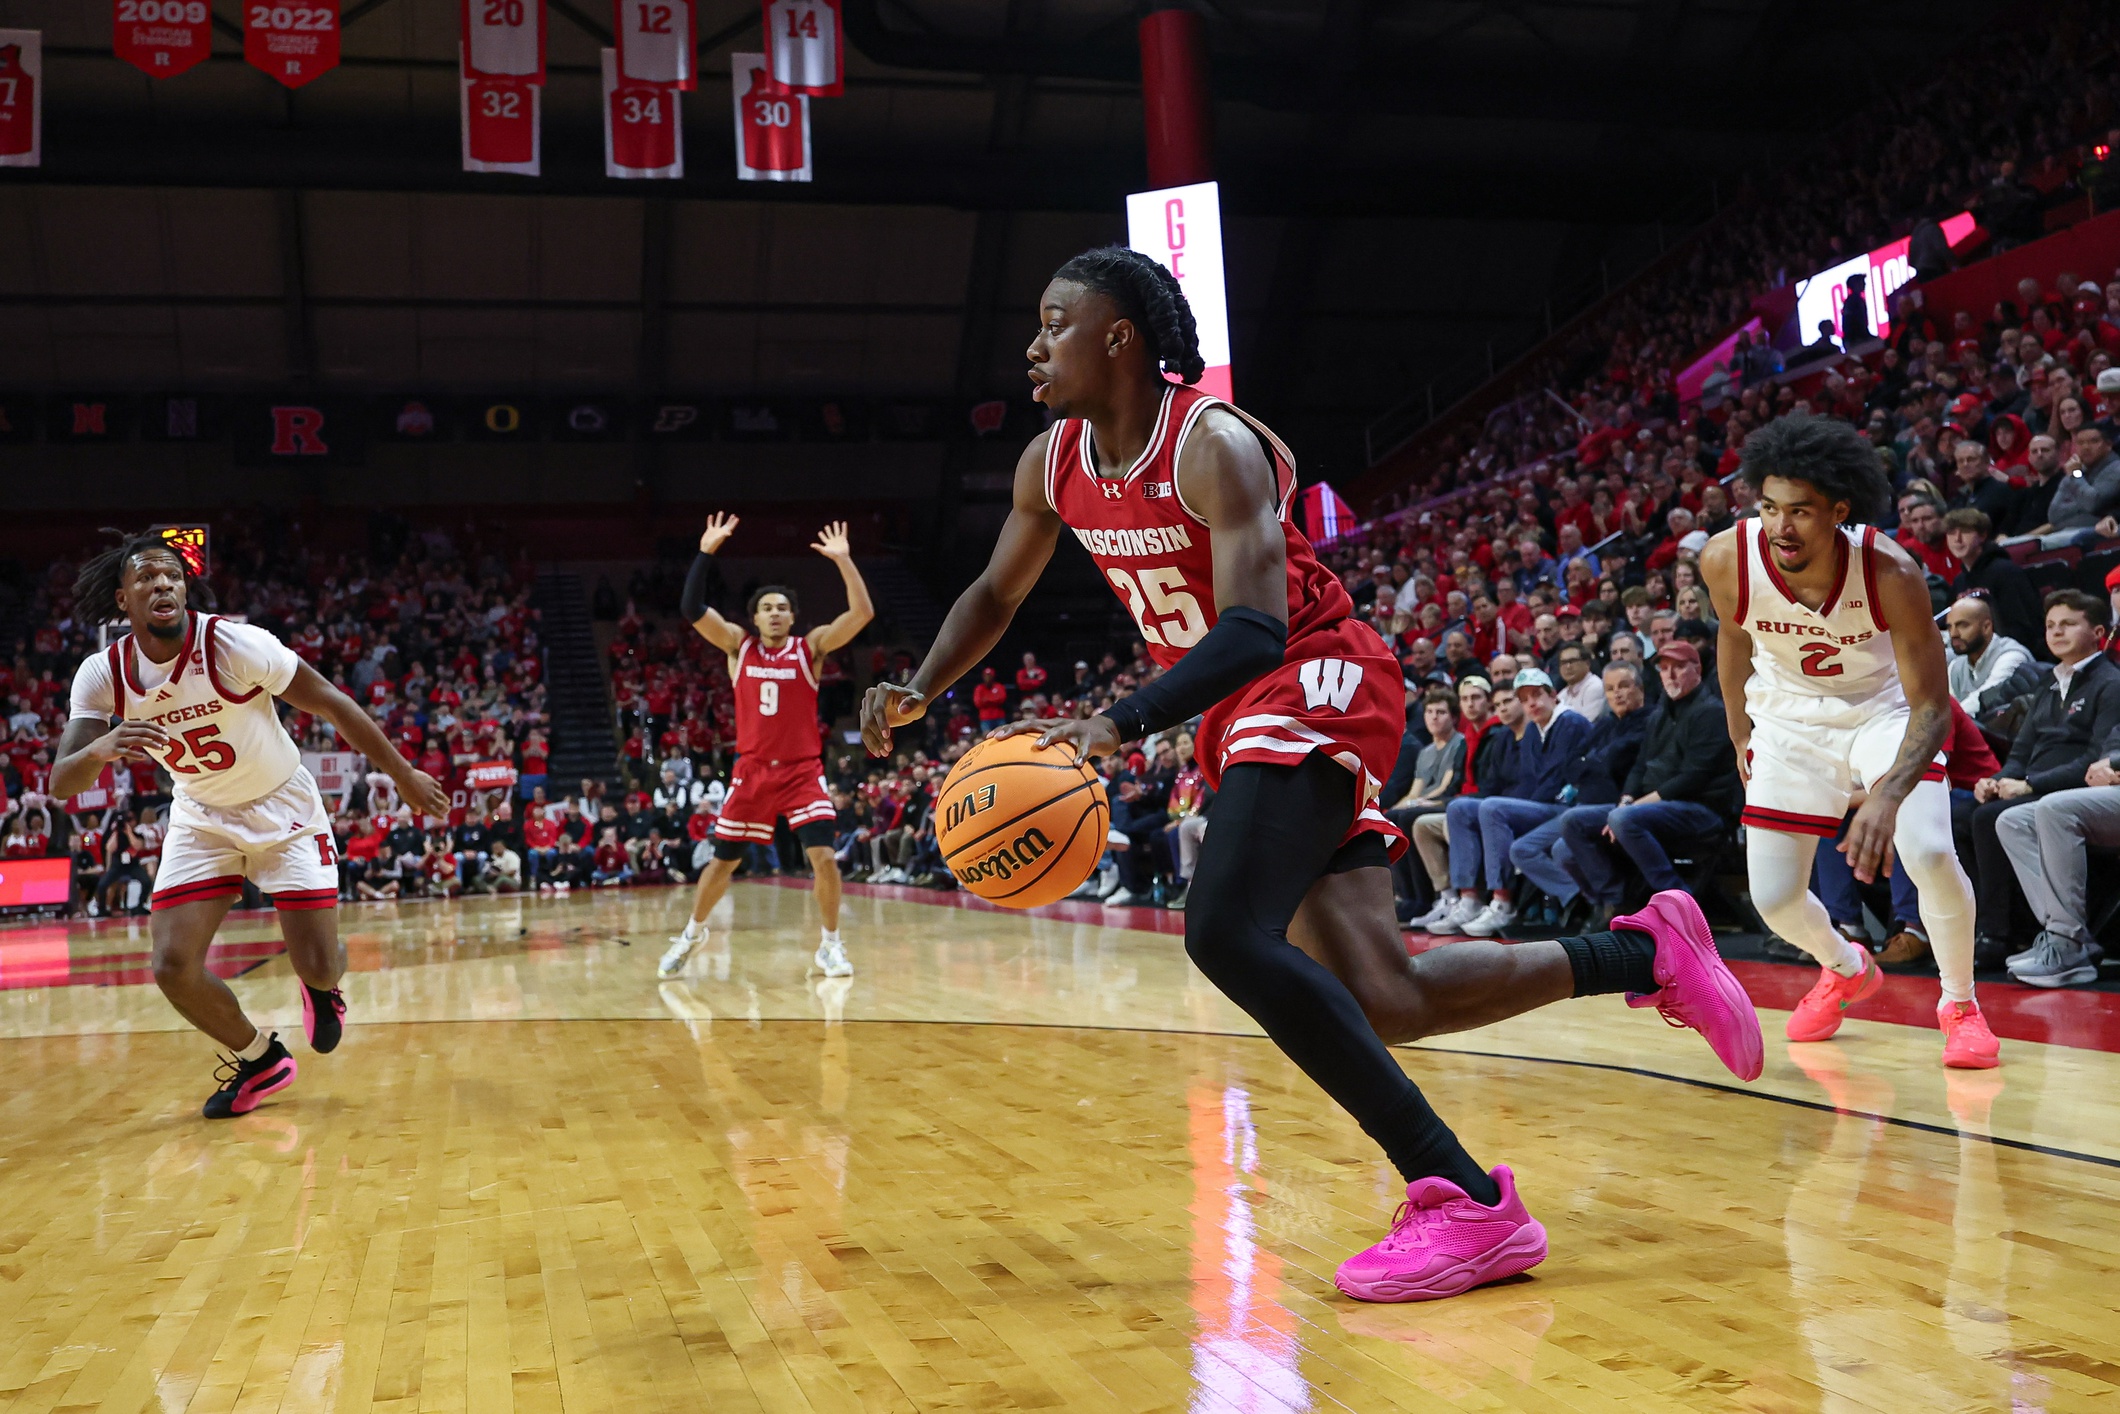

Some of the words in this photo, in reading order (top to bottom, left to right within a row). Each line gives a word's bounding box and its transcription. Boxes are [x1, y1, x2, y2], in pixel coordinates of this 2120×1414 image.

[118, 0, 207, 24] 2009
[250, 5, 334, 31] 2022
[484, 0, 524, 26] 20
[638, 4, 671, 34] 12
[786, 9, 818, 38] 14
[155, 52, 170, 66] R
[285, 60, 301, 74] R
[482, 91, 520, 118] 32
[623, 96, 662, 124] 34
[755, 100, 790, 128] 30
[271, 406, 328, 455] R
[486, 404, 520, 433] O
[1107, 566, 1210, 649] 25
[1756, 619, 1873, 646] RUTGERS
[191, 649, 203, 664] C
[1799, 642, 1844, 677] 2
[758, 681, 779, 716] 9
[1298, 658, 1364, 713] W
[128, 699, 223, 727] TGERS
[161, 724, 236, 774] 25
[955, 827, 1055, 884] Wilson
